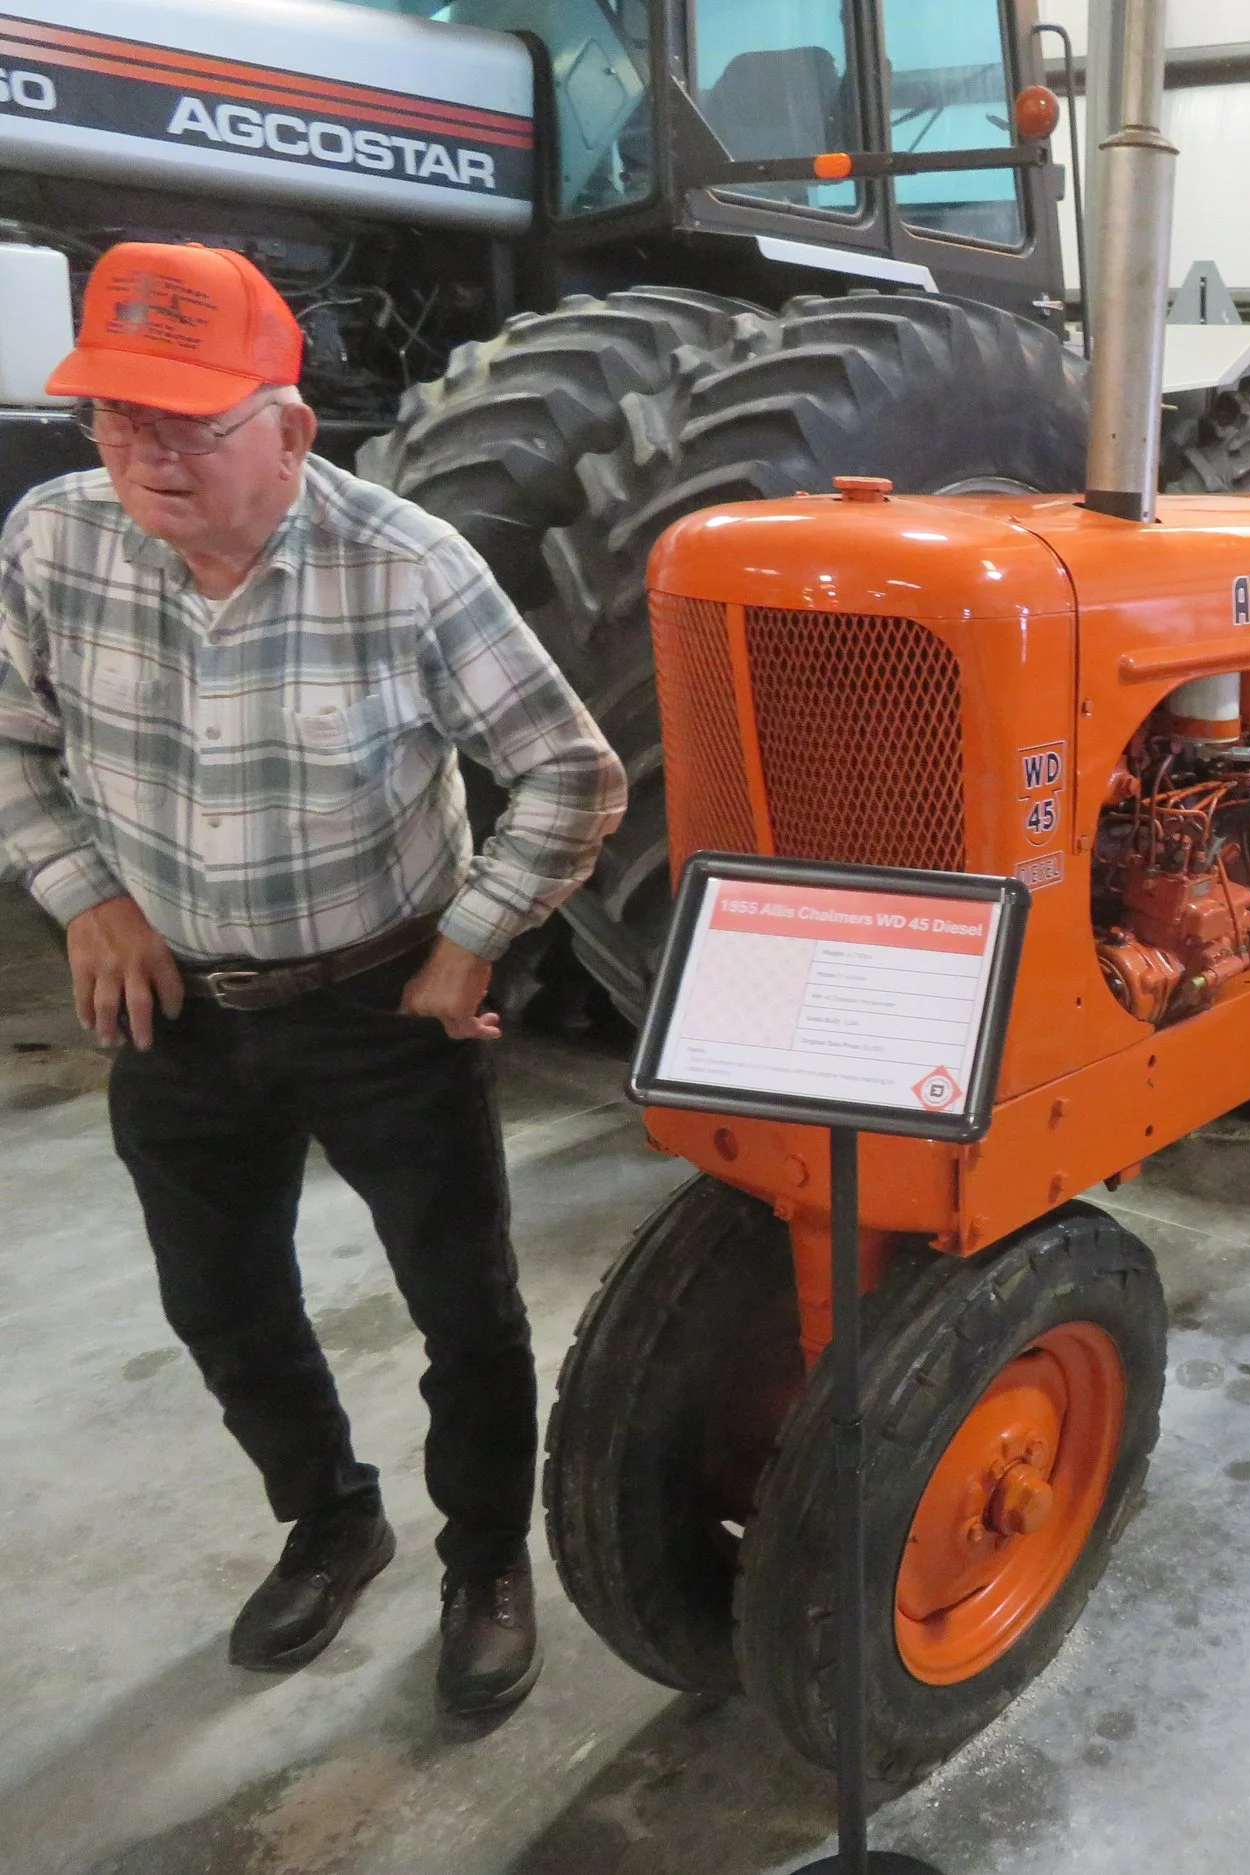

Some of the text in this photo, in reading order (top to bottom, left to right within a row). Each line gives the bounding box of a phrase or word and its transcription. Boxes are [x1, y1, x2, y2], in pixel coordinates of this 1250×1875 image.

[0, 67, 496, 189] 0 AGCOSTAR
[1023, 751, 1062, 790] WD
[1026, 799, 1056, 834] 45
[760, 904, 795, 919] Allis
[799, 907, 874, 926] Chalmers
[876, 914, 907, 929] WD
[908, 918, 929, 932] 45
[932, 919, 983, 937] Diesel
